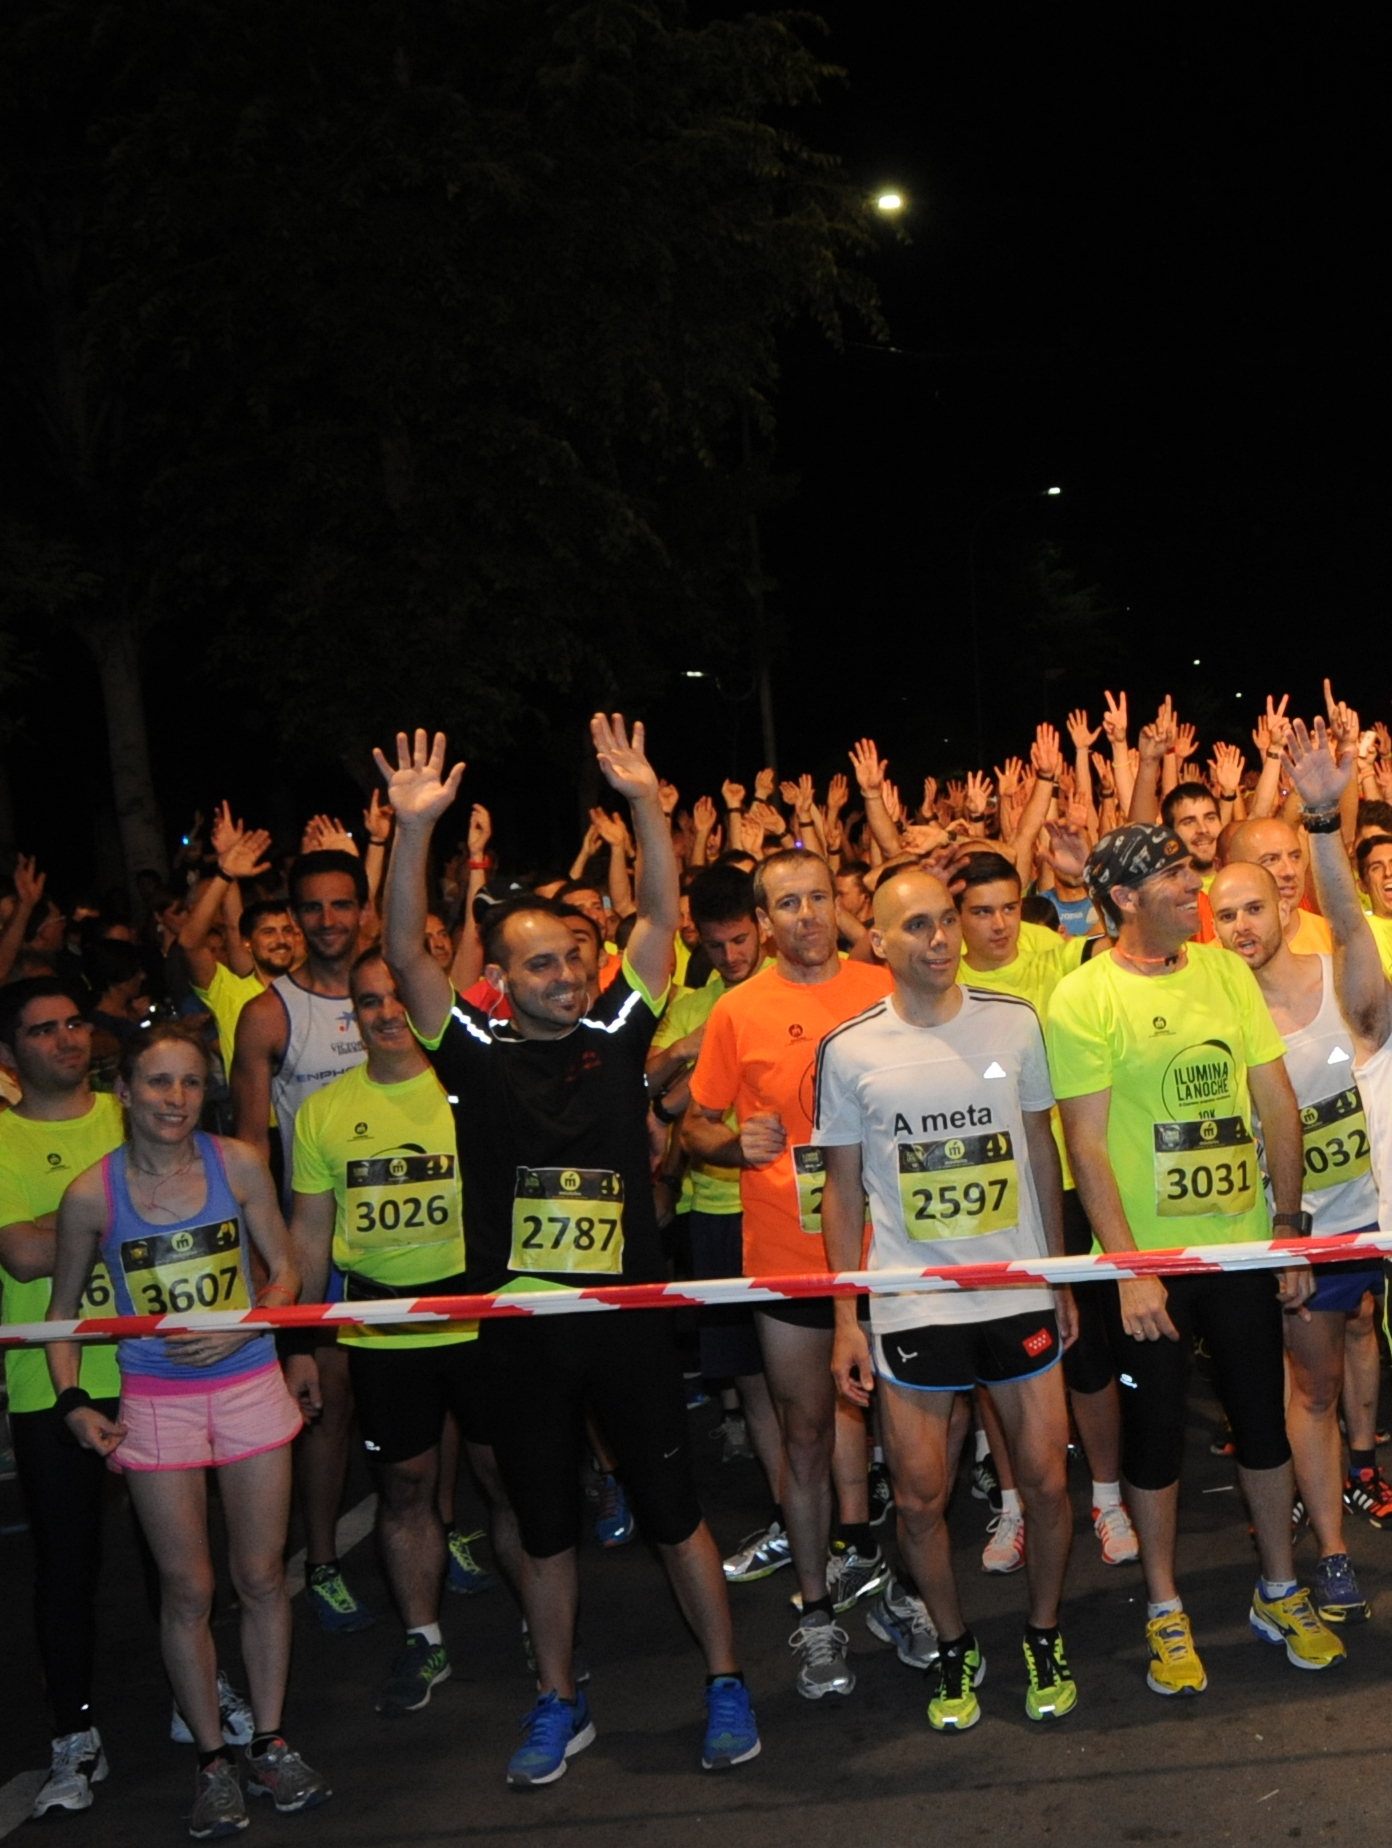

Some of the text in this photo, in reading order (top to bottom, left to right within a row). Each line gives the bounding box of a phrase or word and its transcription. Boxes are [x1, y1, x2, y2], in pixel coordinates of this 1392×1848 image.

[1174, 1061, 1229, 1086] ILUMINA
[894, 1104, 993, 1136] A meta
[1303, 1128, 1371, 1177] 032
[912, 1178, 1008, 1221] 2597
[1167, 1160, 1251, 1200] 3031
[356, 1194, 449, 1233] 3026
[521, 1215, 618, 1252] 2787
[142, 1266, 238, 1316] 3607
